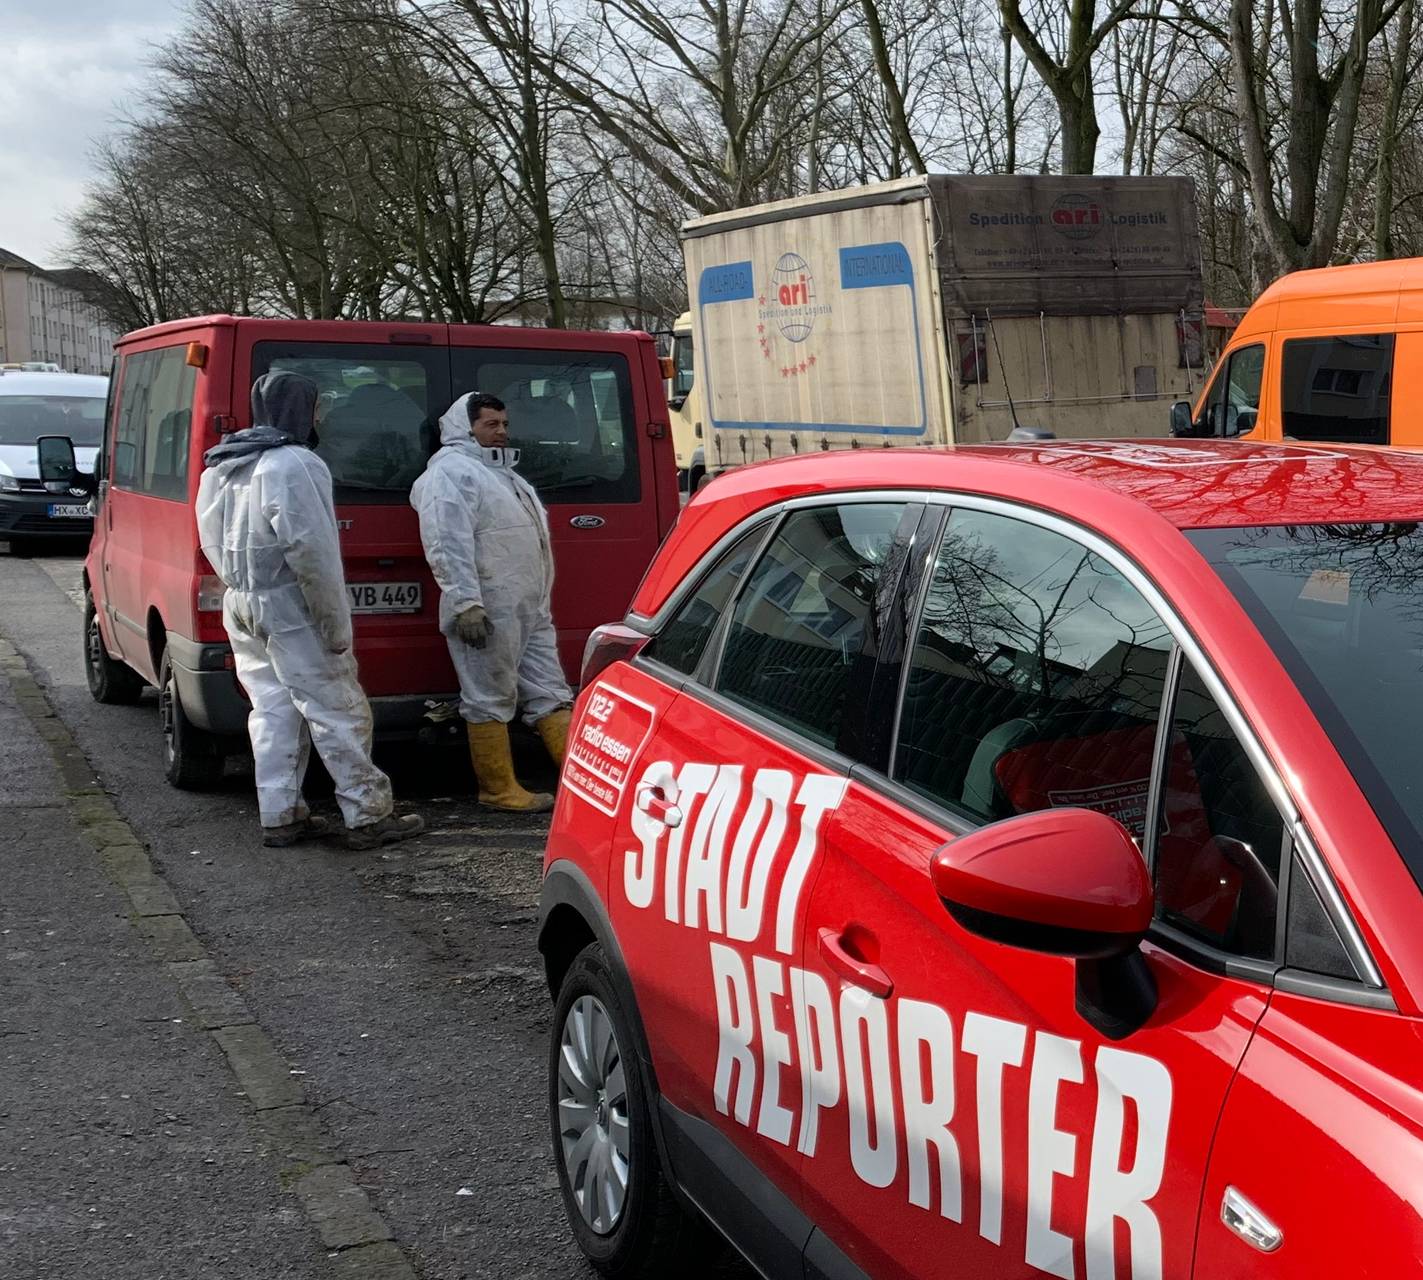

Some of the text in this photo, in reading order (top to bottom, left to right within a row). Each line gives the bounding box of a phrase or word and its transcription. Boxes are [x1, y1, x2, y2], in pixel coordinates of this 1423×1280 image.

[969, 204, 1168, 228] Spedition ari Logistik
[778, 274, 807, 305] ari
[350, 585, 419, 607] YB 449
[580, 724, 631, 764] radio essen
[624, 760, 851, 955] STADT
[708, 942, 1173, 1280] REPORTER
